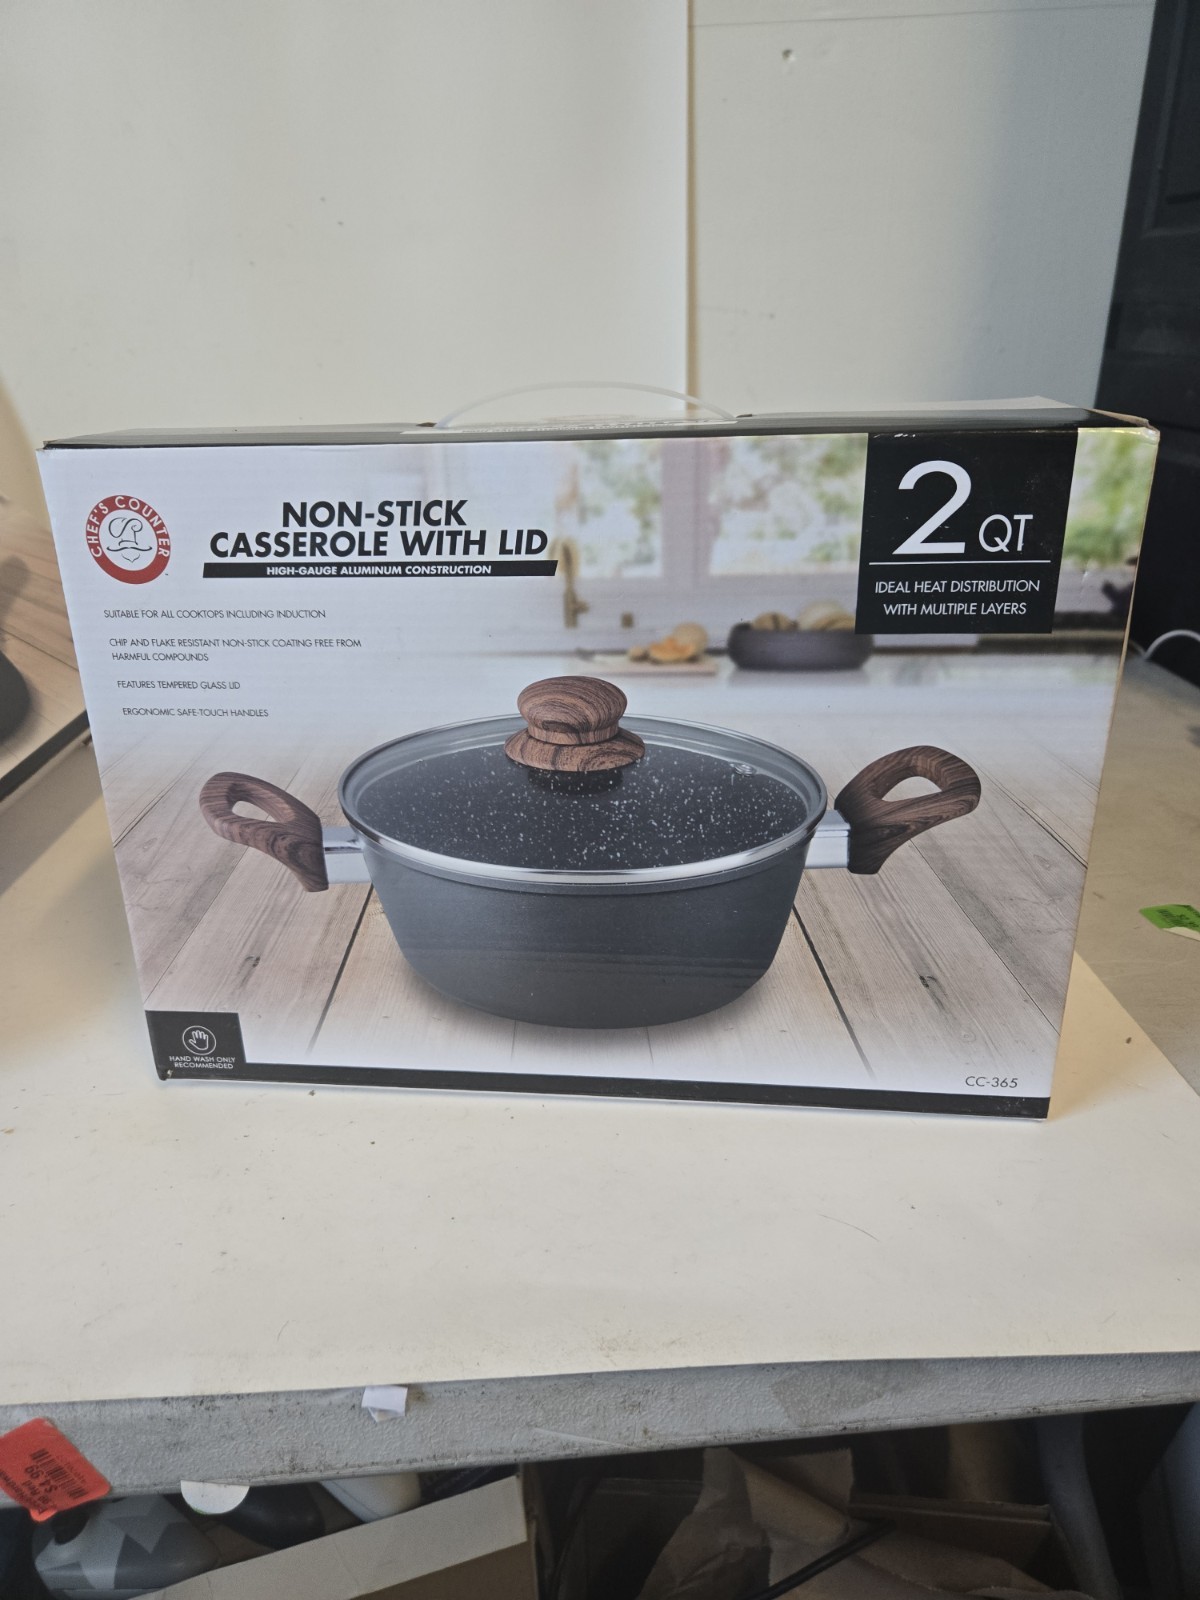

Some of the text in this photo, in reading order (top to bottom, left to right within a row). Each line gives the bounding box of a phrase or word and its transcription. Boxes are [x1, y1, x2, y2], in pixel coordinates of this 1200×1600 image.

[282, 499, 469, 528] NON-STICK
[892, 459, 972, 555] 2
[86, 503, 109, 558] CHEF'S
[114, 496, 170, 557] COUNTER
[978, 513, 1034, 553] QT
[209, 529, 549, 558] CASSEROLE WITH LID
[266, 564, 492, 576] HIGH-GAUGE ALUMINUM CONSTRUCTION
[875, 579, 1041, 594] IDEAL HEAT DISTRIBUTION
[103, 609, 326, 619] SUITABLE FOR ALL COOKTOPS INCLUDING INDUCTION
[883, 602, 1027, 615] WITH MULTIPLE LAYERS
[109, 638, 362, 648] CHIP AND FLAKE RESISTANT NON-STICK COATING FREE FROM
[111, 652, 209, 662] HARMFUL COMPOUNDS
[117, 680, 241, 690] FEATURES TEMPERED GLASS LID
[122, 707, 269, 718] ERGONOMIC SAFE-TOUCH HANDLES
[174, 1061, 234, 1069] RECOMMENDED
[965, 1075, 1019, 1089] CC-365
[24, 1464, 59, 1494] $4.99
